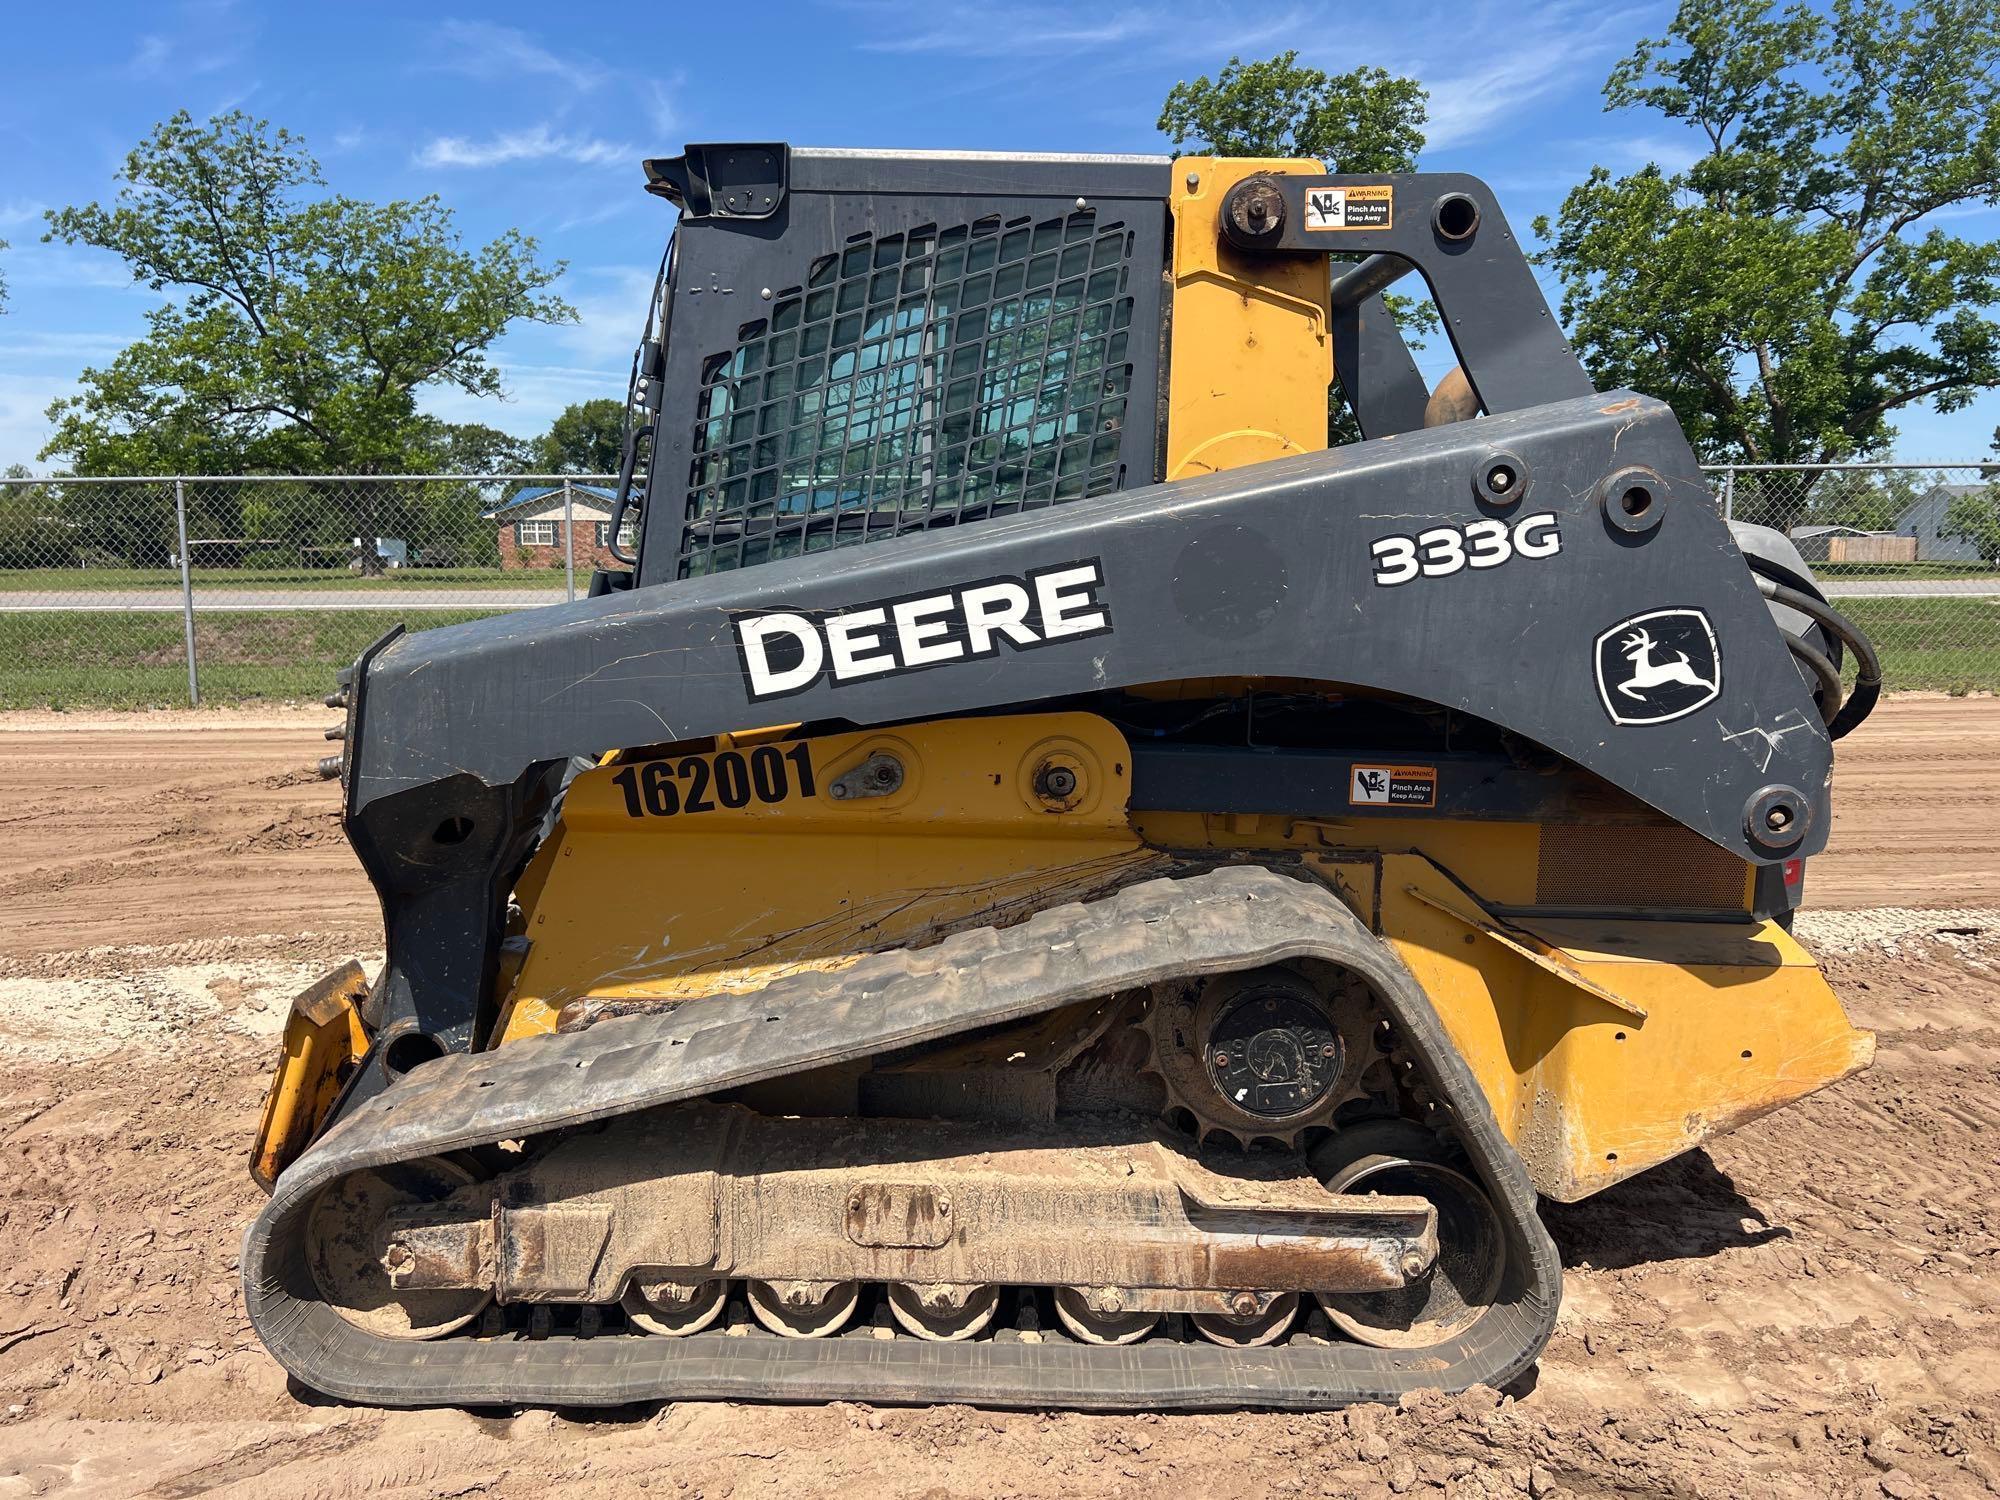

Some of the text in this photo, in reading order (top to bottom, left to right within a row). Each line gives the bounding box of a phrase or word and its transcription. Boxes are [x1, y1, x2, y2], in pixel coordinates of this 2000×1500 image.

[1347, 205, 1369, 213] Pinch
[1371, 513, 1561, 586] 333G
[737, 564, 1106, 697] DEERE
[611, 741, 817, 818] 162001
[1414, 784, 1431, 792] Area
